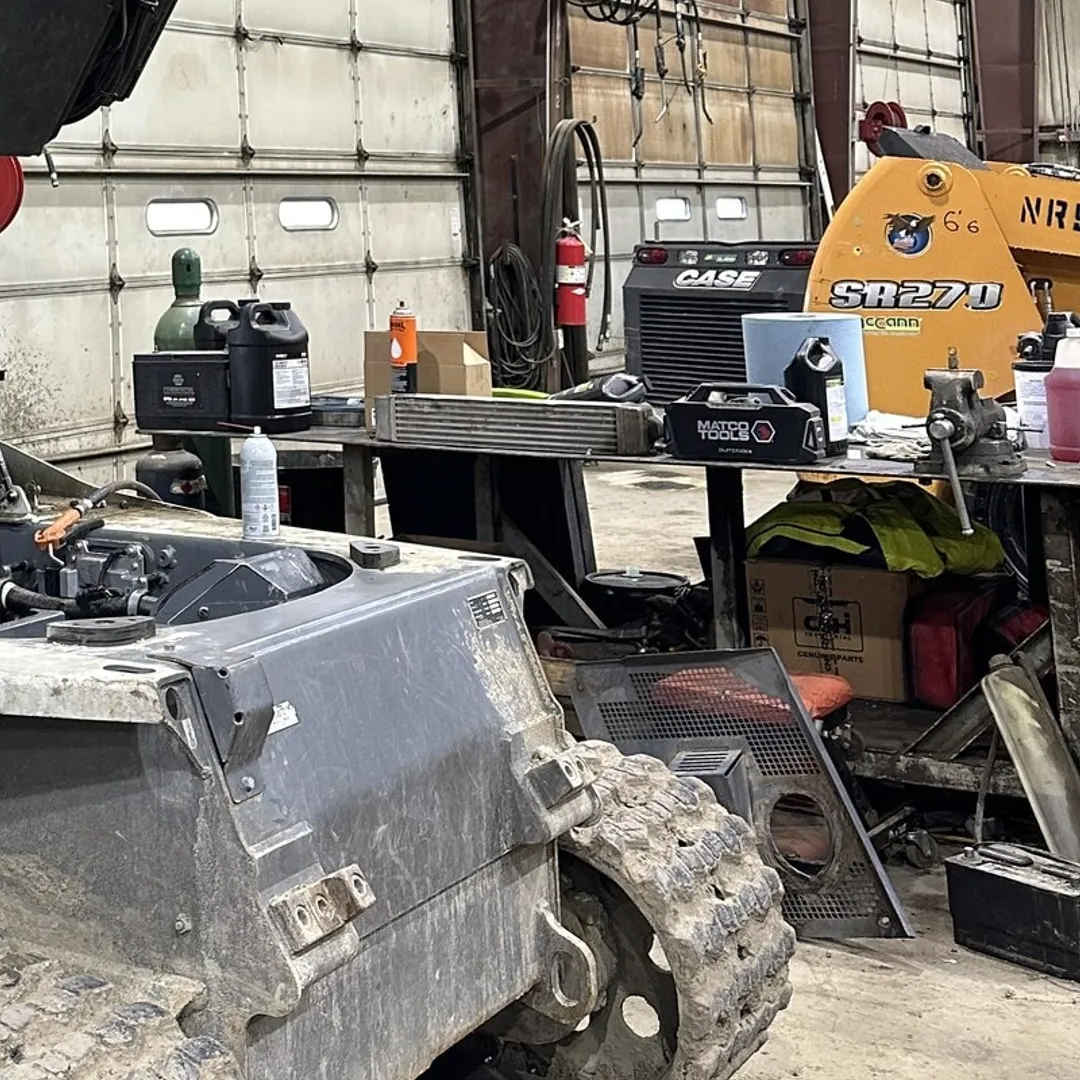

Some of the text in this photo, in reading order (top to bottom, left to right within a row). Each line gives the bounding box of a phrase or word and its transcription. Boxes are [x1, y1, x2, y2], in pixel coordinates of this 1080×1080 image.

[676, 270, 761, 288] CASE
[828, 279, 1004, 310] SR270
[697, 420, 750, 431] MATCO
[698, 430, 750, 441] TOOLS
[803, 611, 852, 635] CH
[836, 654, 864, 663] PARTS
